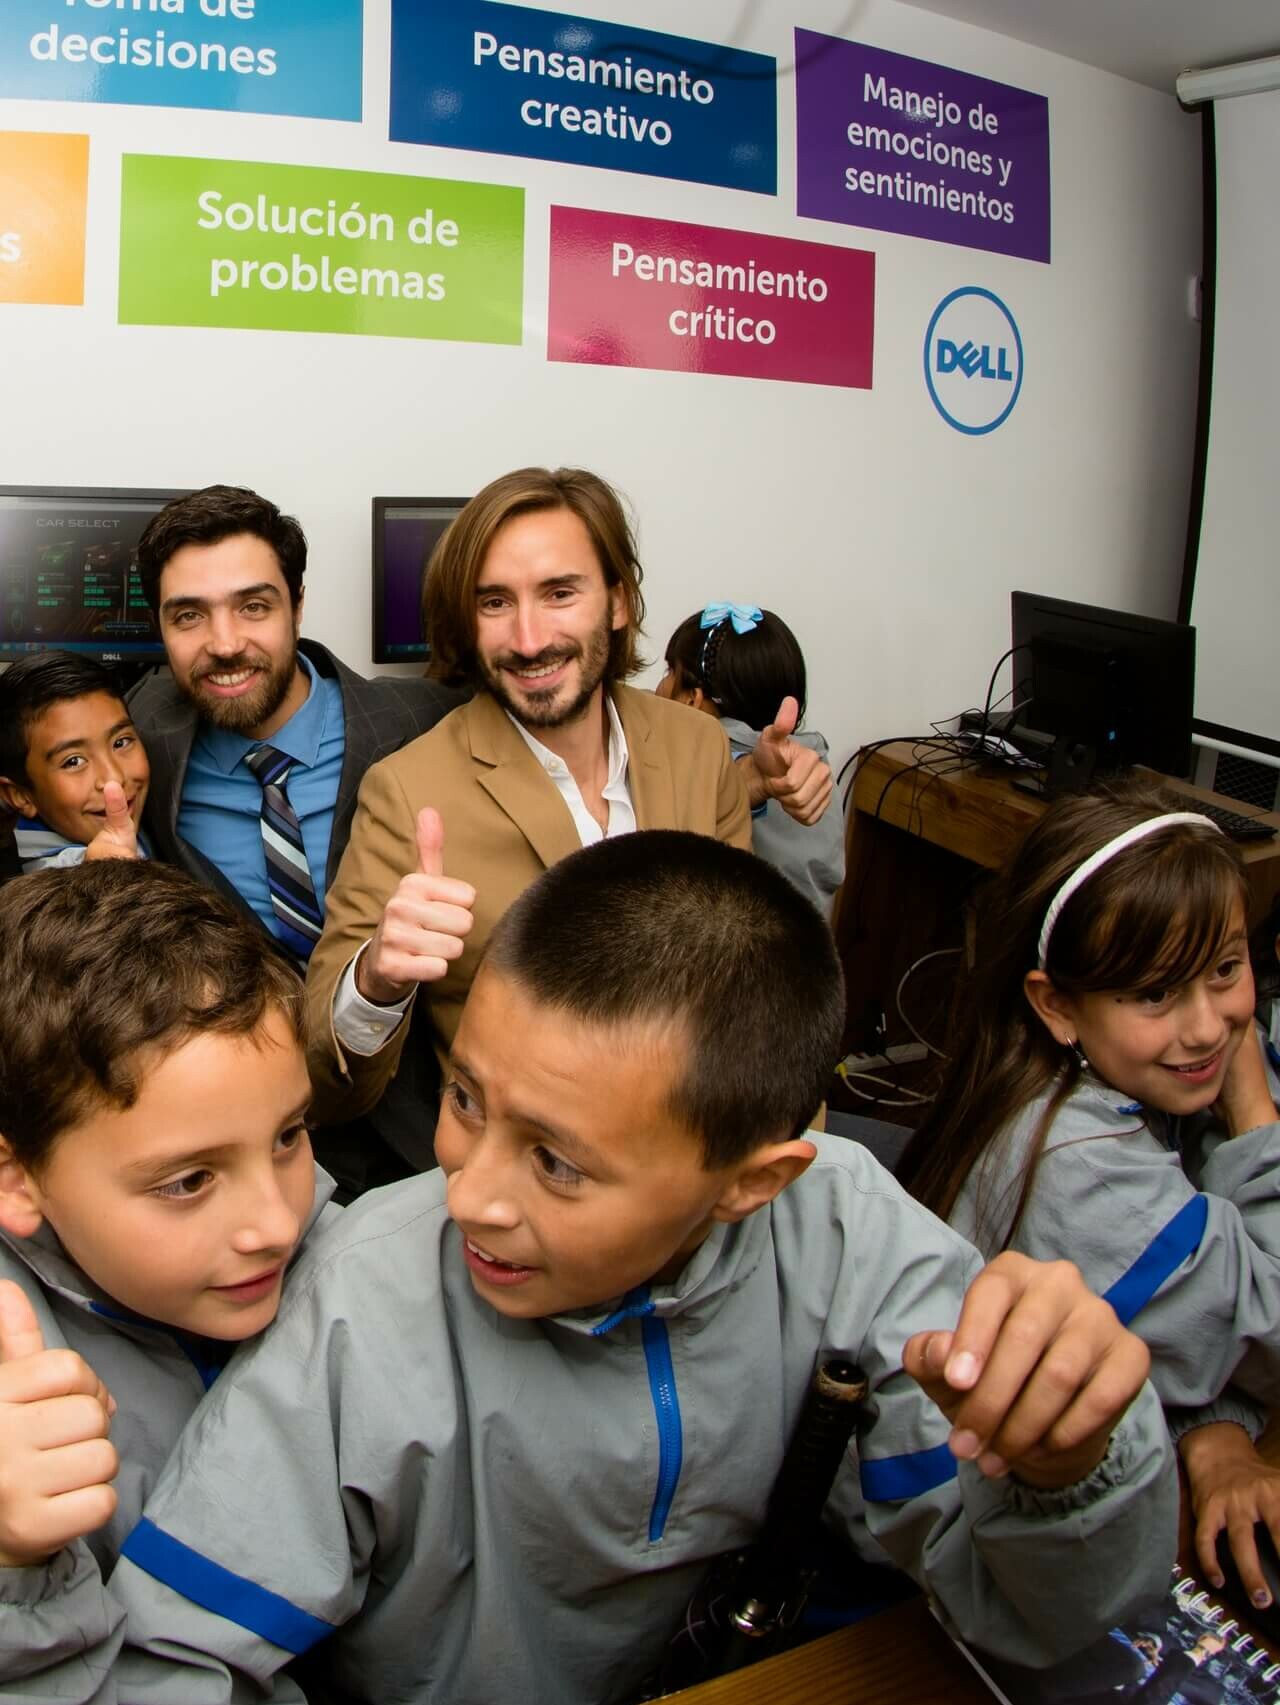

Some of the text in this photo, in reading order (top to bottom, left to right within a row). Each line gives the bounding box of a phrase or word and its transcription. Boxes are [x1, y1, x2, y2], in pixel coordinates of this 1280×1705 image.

[29, 23, 278, 77] decisiones
[473, 31, 715, 104] Pensamiento
[520, 99, 672, 146] creativo
[863, 73, 999, 135] Manejo de
[846, 121, 1013, 187] emociones y
[197, 190, 459, 248] Solución de
[844, 167, 1015, 224] sentimientos
[210, 253, 446, 302] problemas
[611, 243, 828, 303] Pensamiento
[668, 304, 776, 345] crítico
[936, 338, 1012, 381] DELL
[36, 518, 121, 529] CAR SELECT
